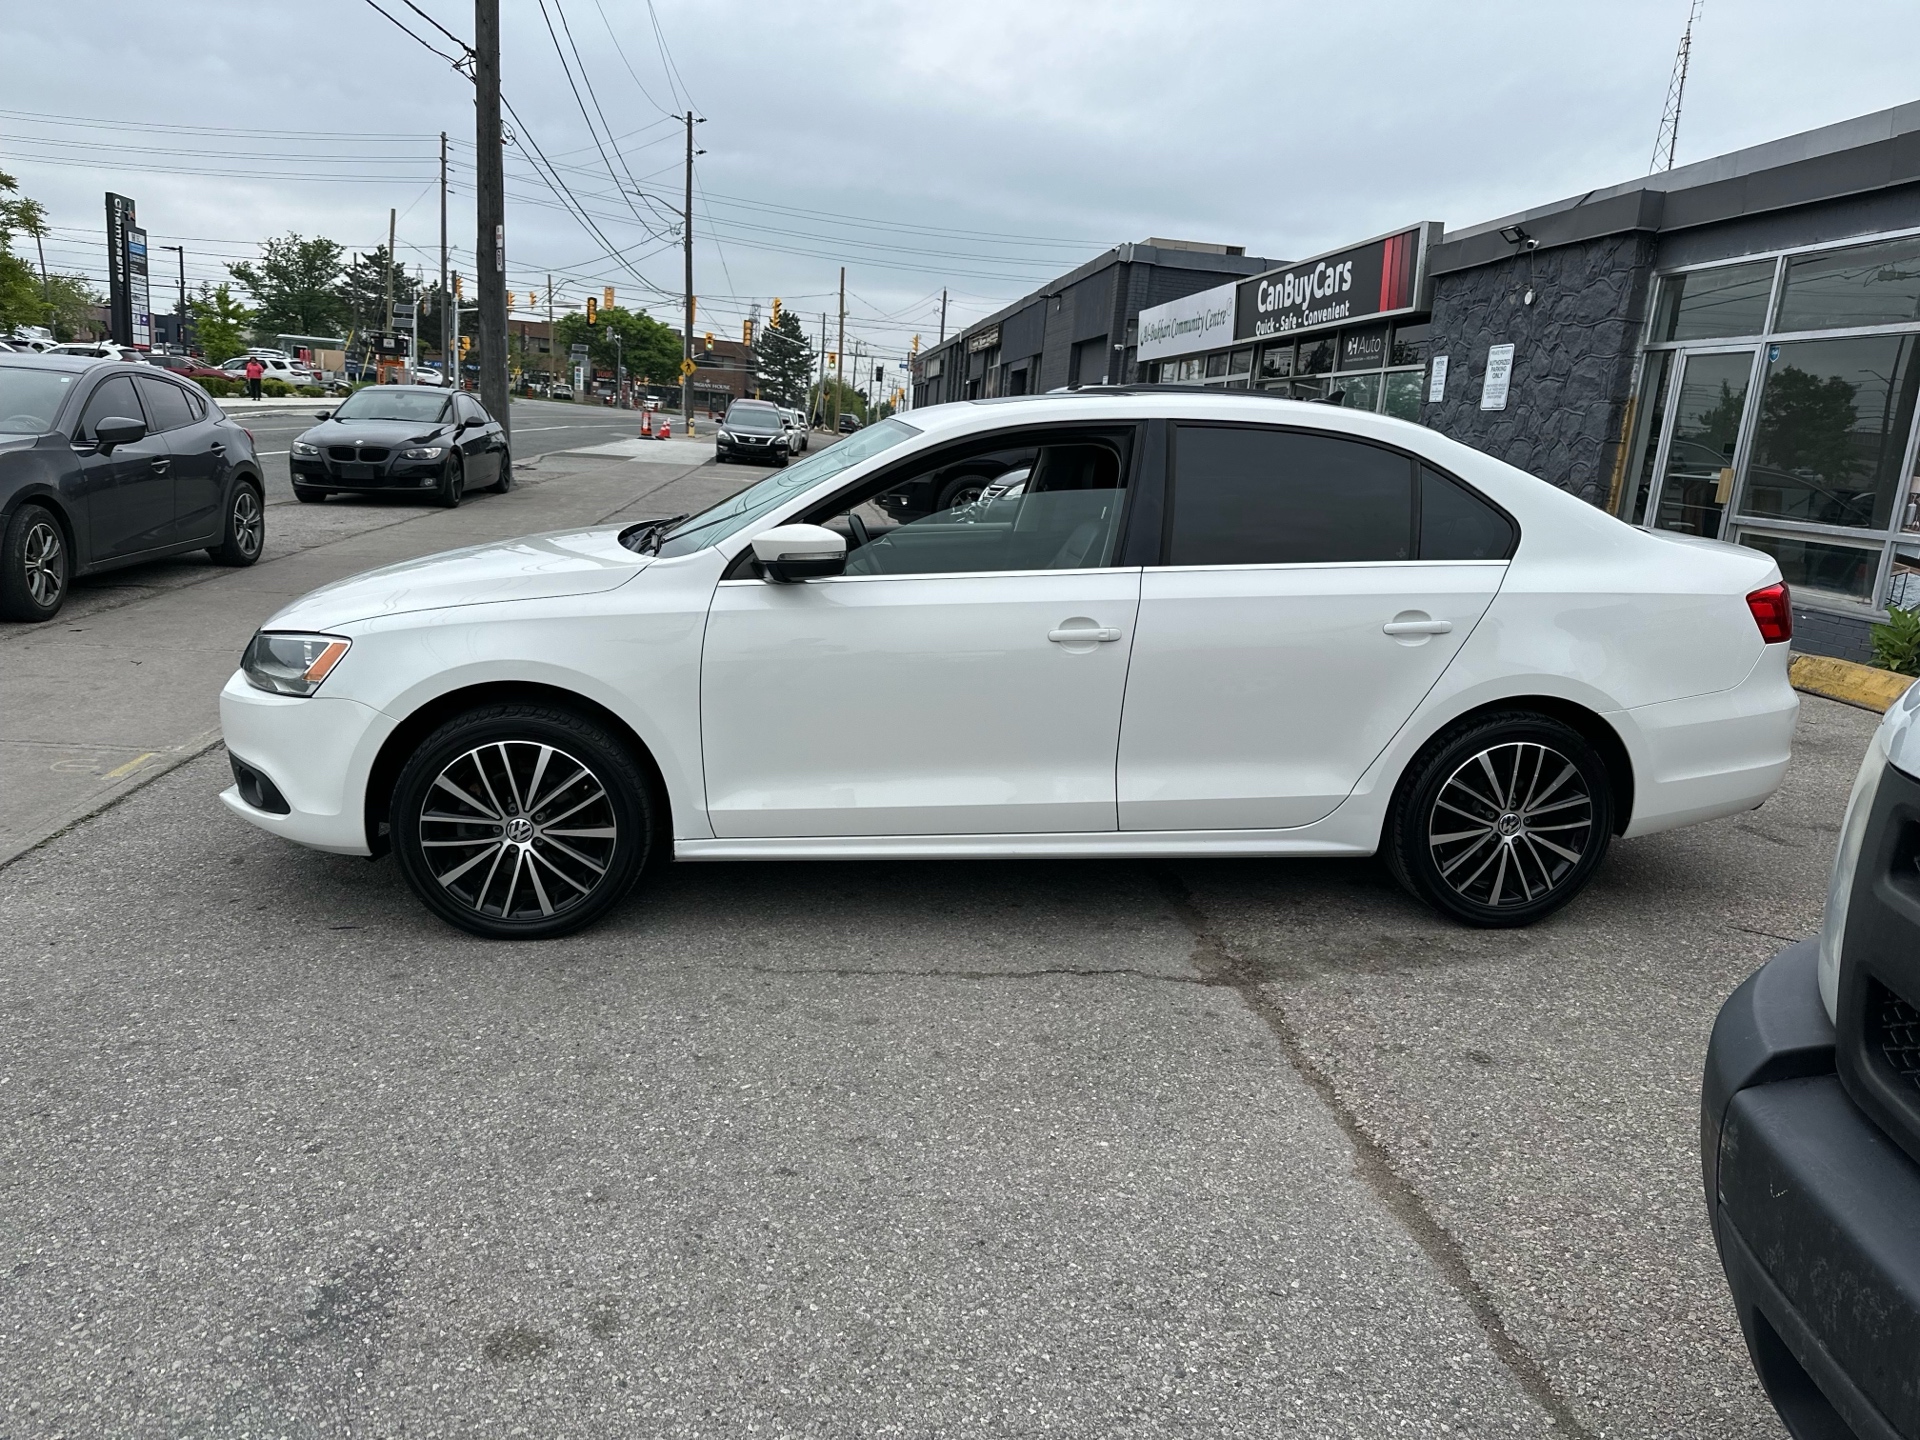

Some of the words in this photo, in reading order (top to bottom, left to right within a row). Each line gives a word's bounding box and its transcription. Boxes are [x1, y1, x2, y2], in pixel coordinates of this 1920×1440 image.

[114, 198, 124, 283] Champagne
[1257, 261, 1353, 313] CanBuyCars
[1171, 311, 1205, 338] Community
[1205, 309, 1227, 331] Centre
[1255, 317, 1275, 337] Quick
[1280, 312, 1297, 331] Safe
[1303, 300, 1350, 326] Convenient
[1357, 335, 1382, 354] Auto
